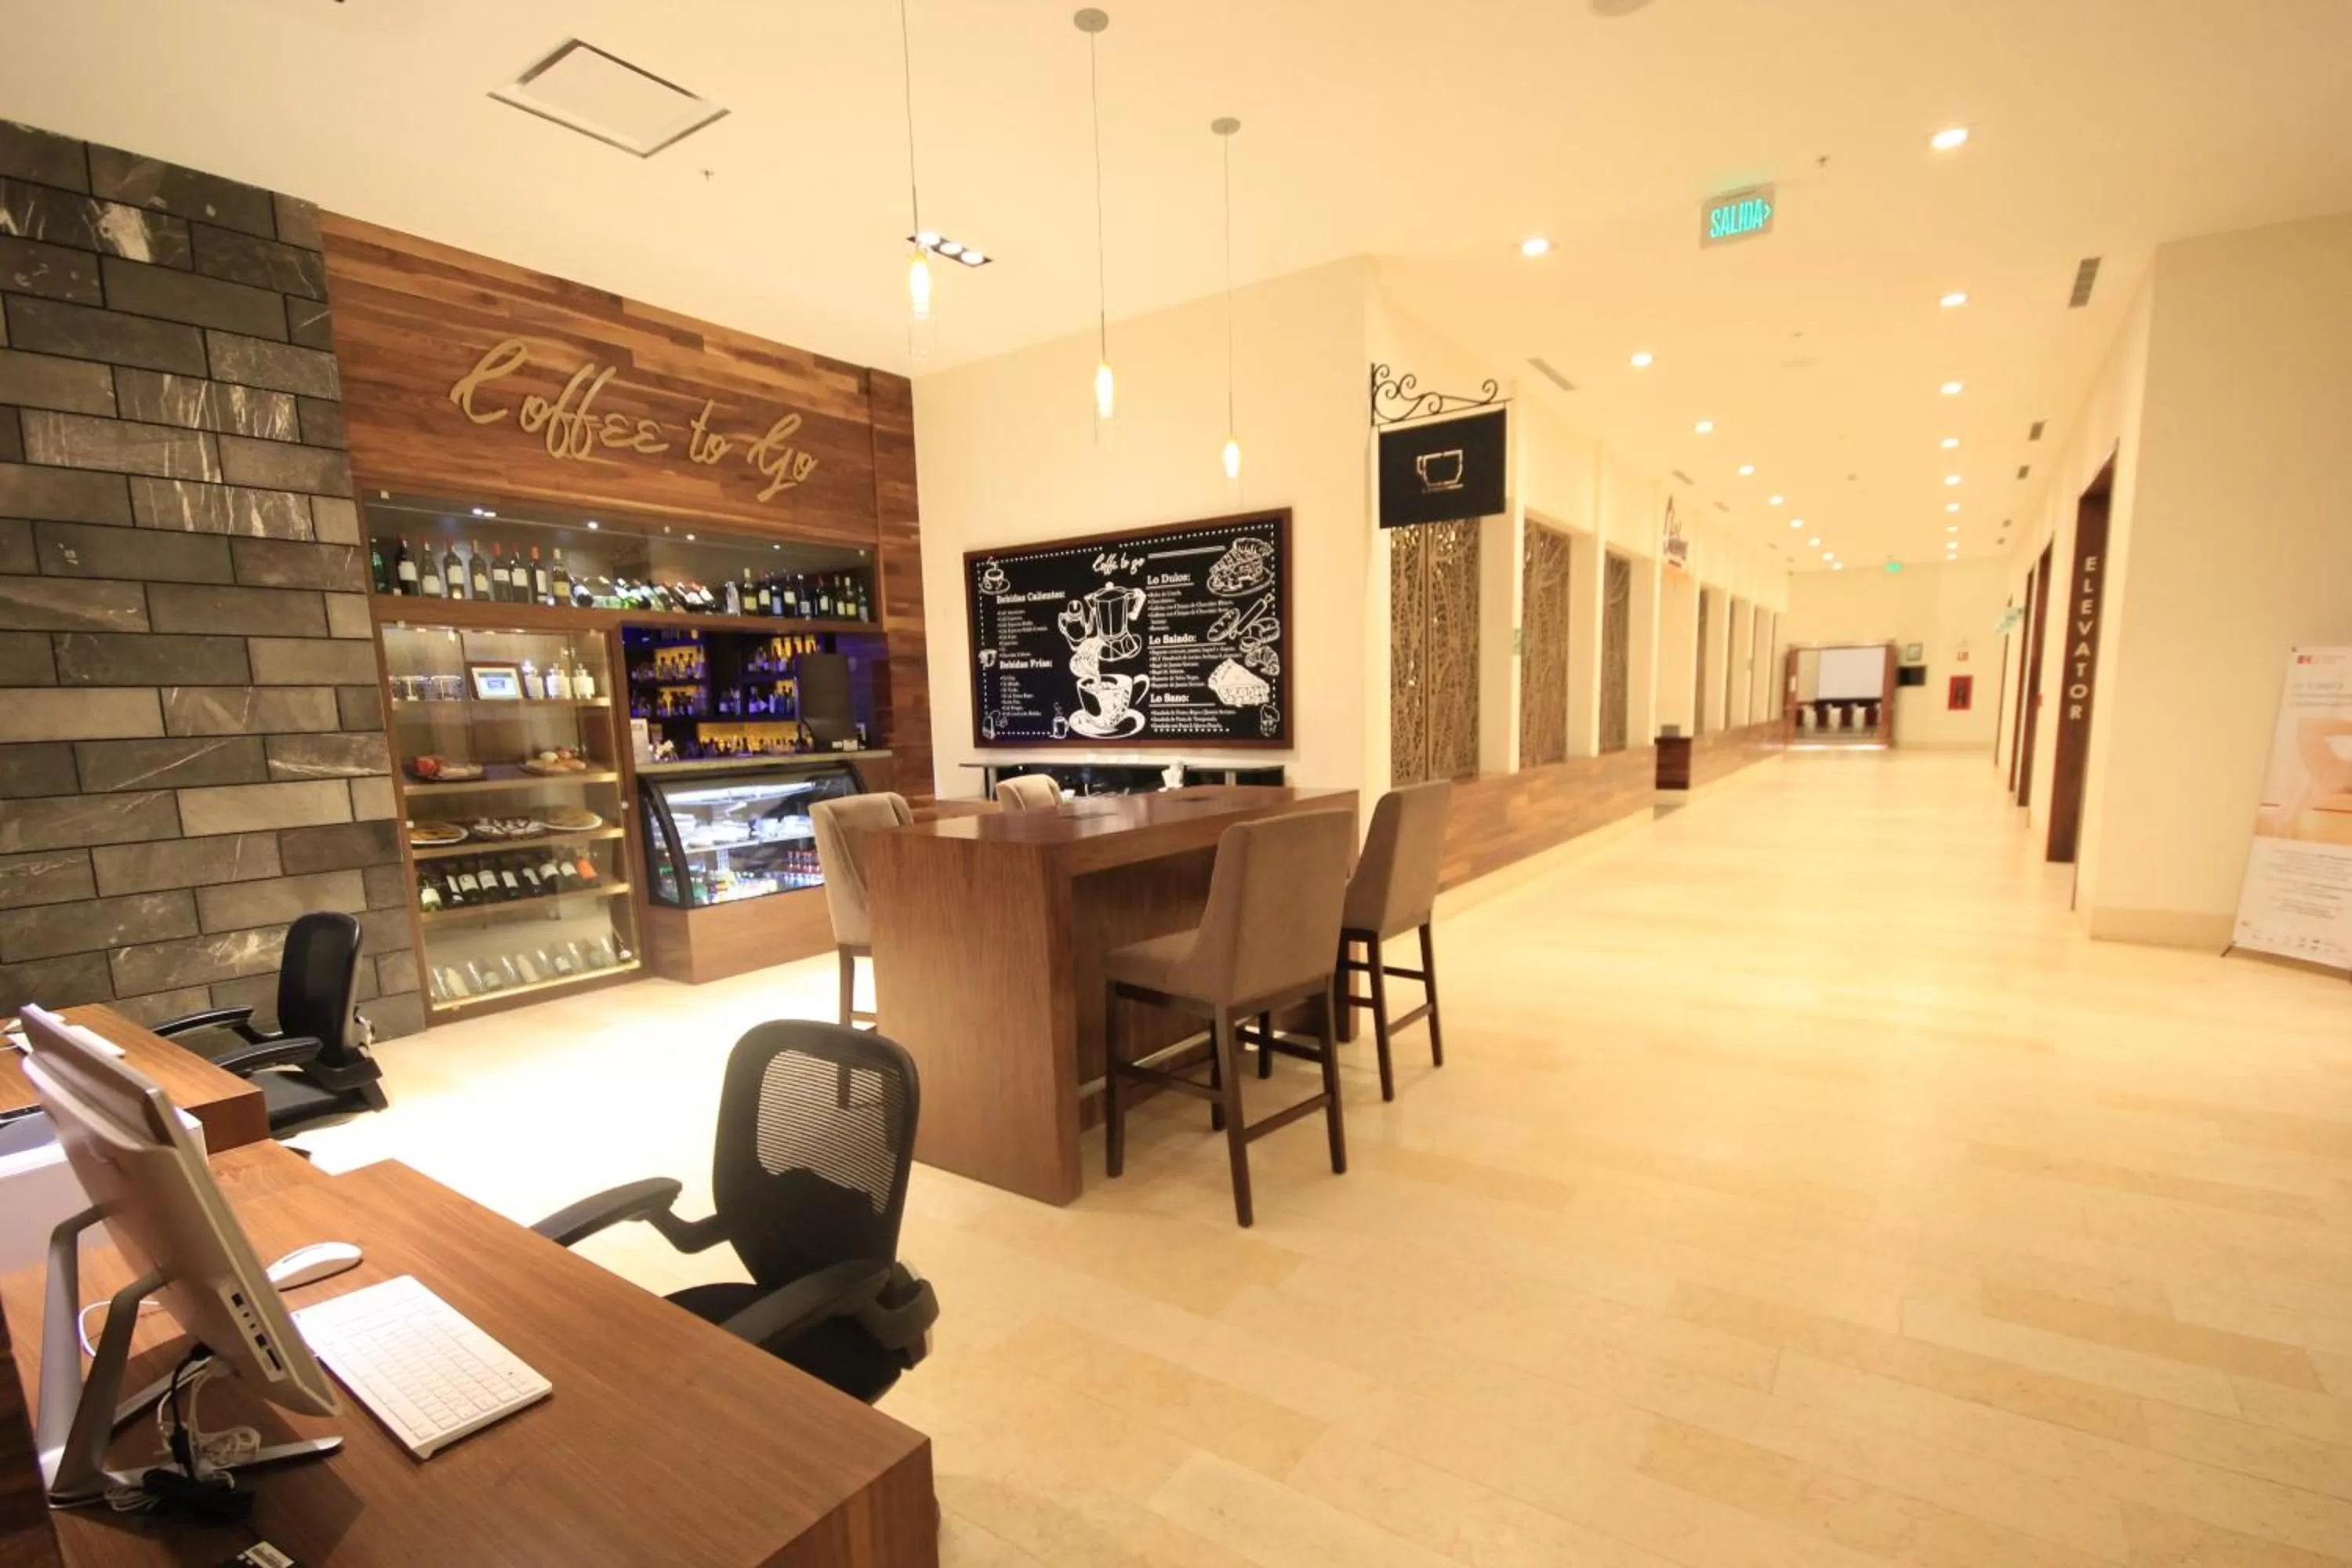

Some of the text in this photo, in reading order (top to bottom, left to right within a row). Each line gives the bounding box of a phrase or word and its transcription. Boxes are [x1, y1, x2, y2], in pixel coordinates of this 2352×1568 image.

[1710, 198, 1763, 238] SALIDA
[450, 338, 818, 503] Coffee to Go
[1147, 575, 1160, 586] Lo
[1149, 633, 1197, 645] Lo Salado:
[2068, 556, 2099, 720] ELEVATOR
[1150, 693, 1163, 703] Lo
